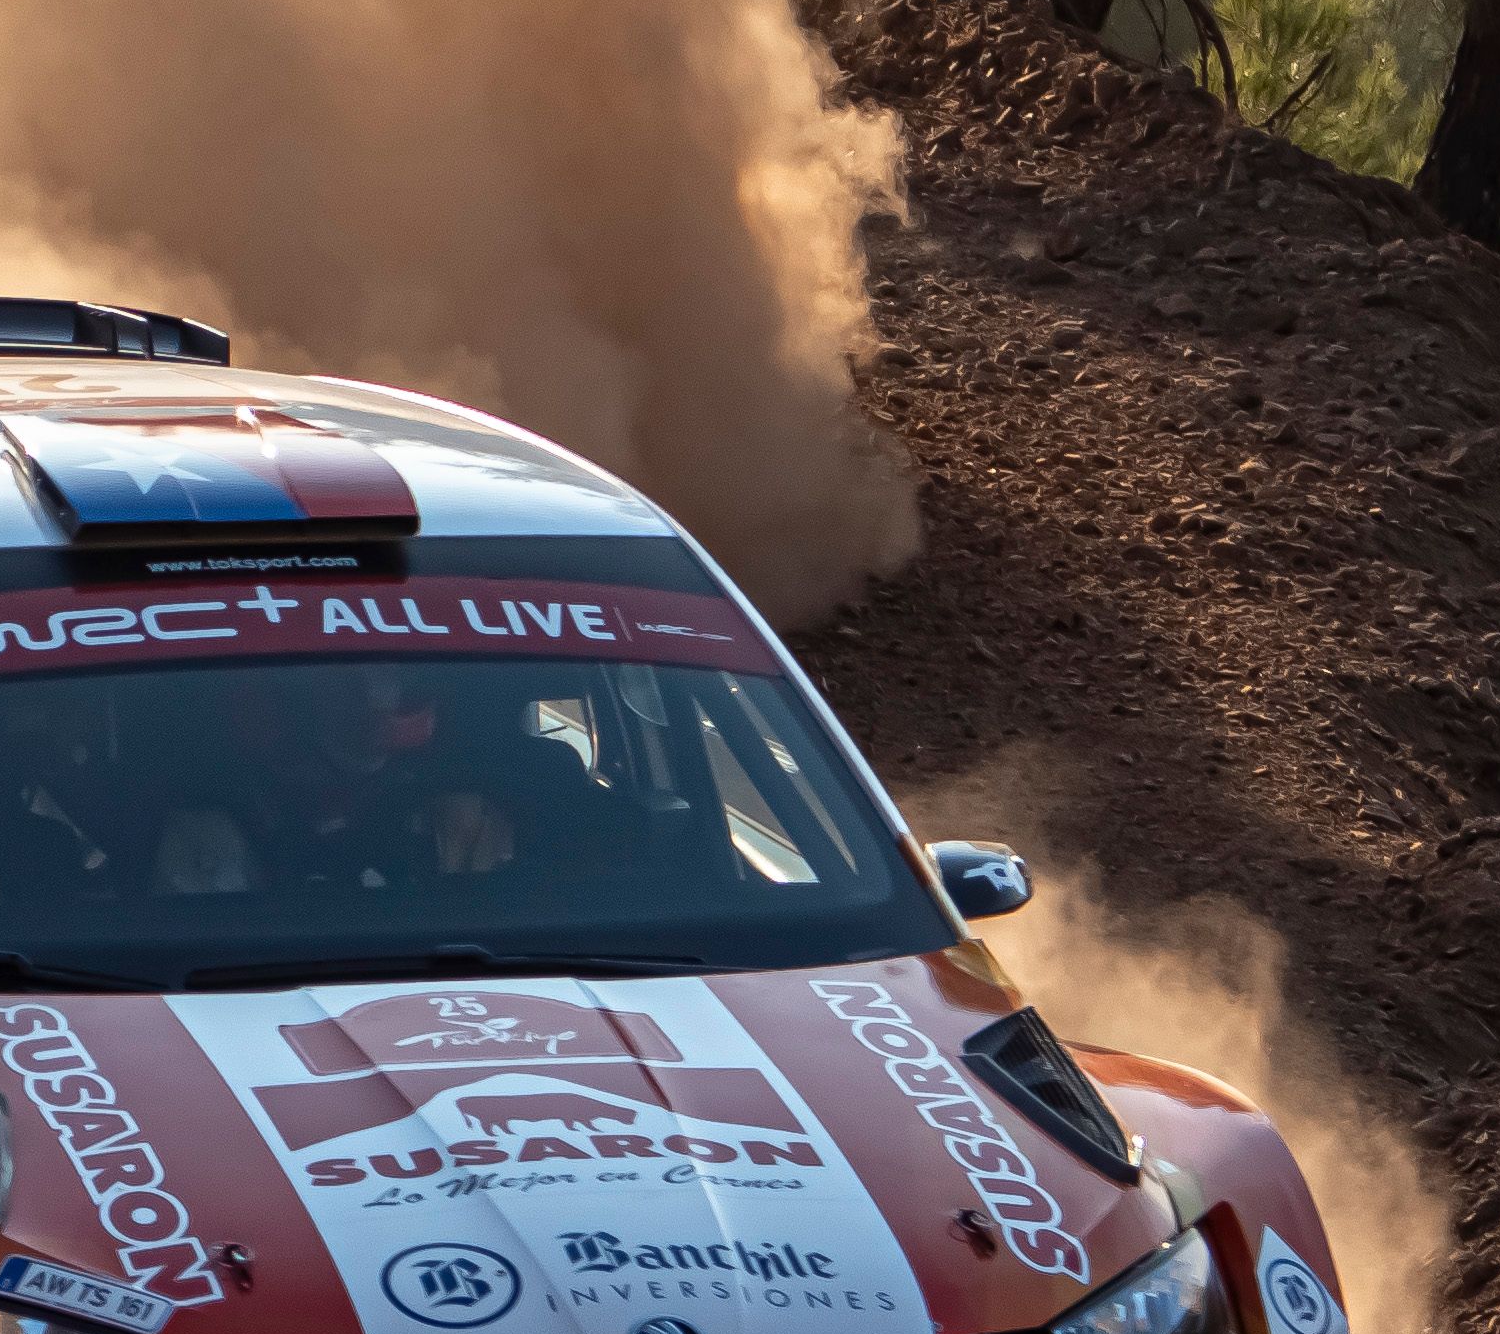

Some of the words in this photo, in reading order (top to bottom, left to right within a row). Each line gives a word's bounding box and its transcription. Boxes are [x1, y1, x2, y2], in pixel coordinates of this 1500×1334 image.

[145, 555, 360, 574] www.toksport.com
[322, 597, 450, 636] ALL
[459, 598, 617, 642] LIVE
[428, 996, 488, 1017] 25
[808, 979, 1090, 1286] SUSARON
[304, 1133, 826, 1188] SUSARON
[436, 1172, 578, 1198] Mejor
[595, 1171, 640, 1183] en
[556, 1230, 839, 1282] Banchile
[25, 1270, 76, 1297] AW
[77, 1281, 112, 1308] TS
[545, 1280, 896, 1313] INVERSIONES
